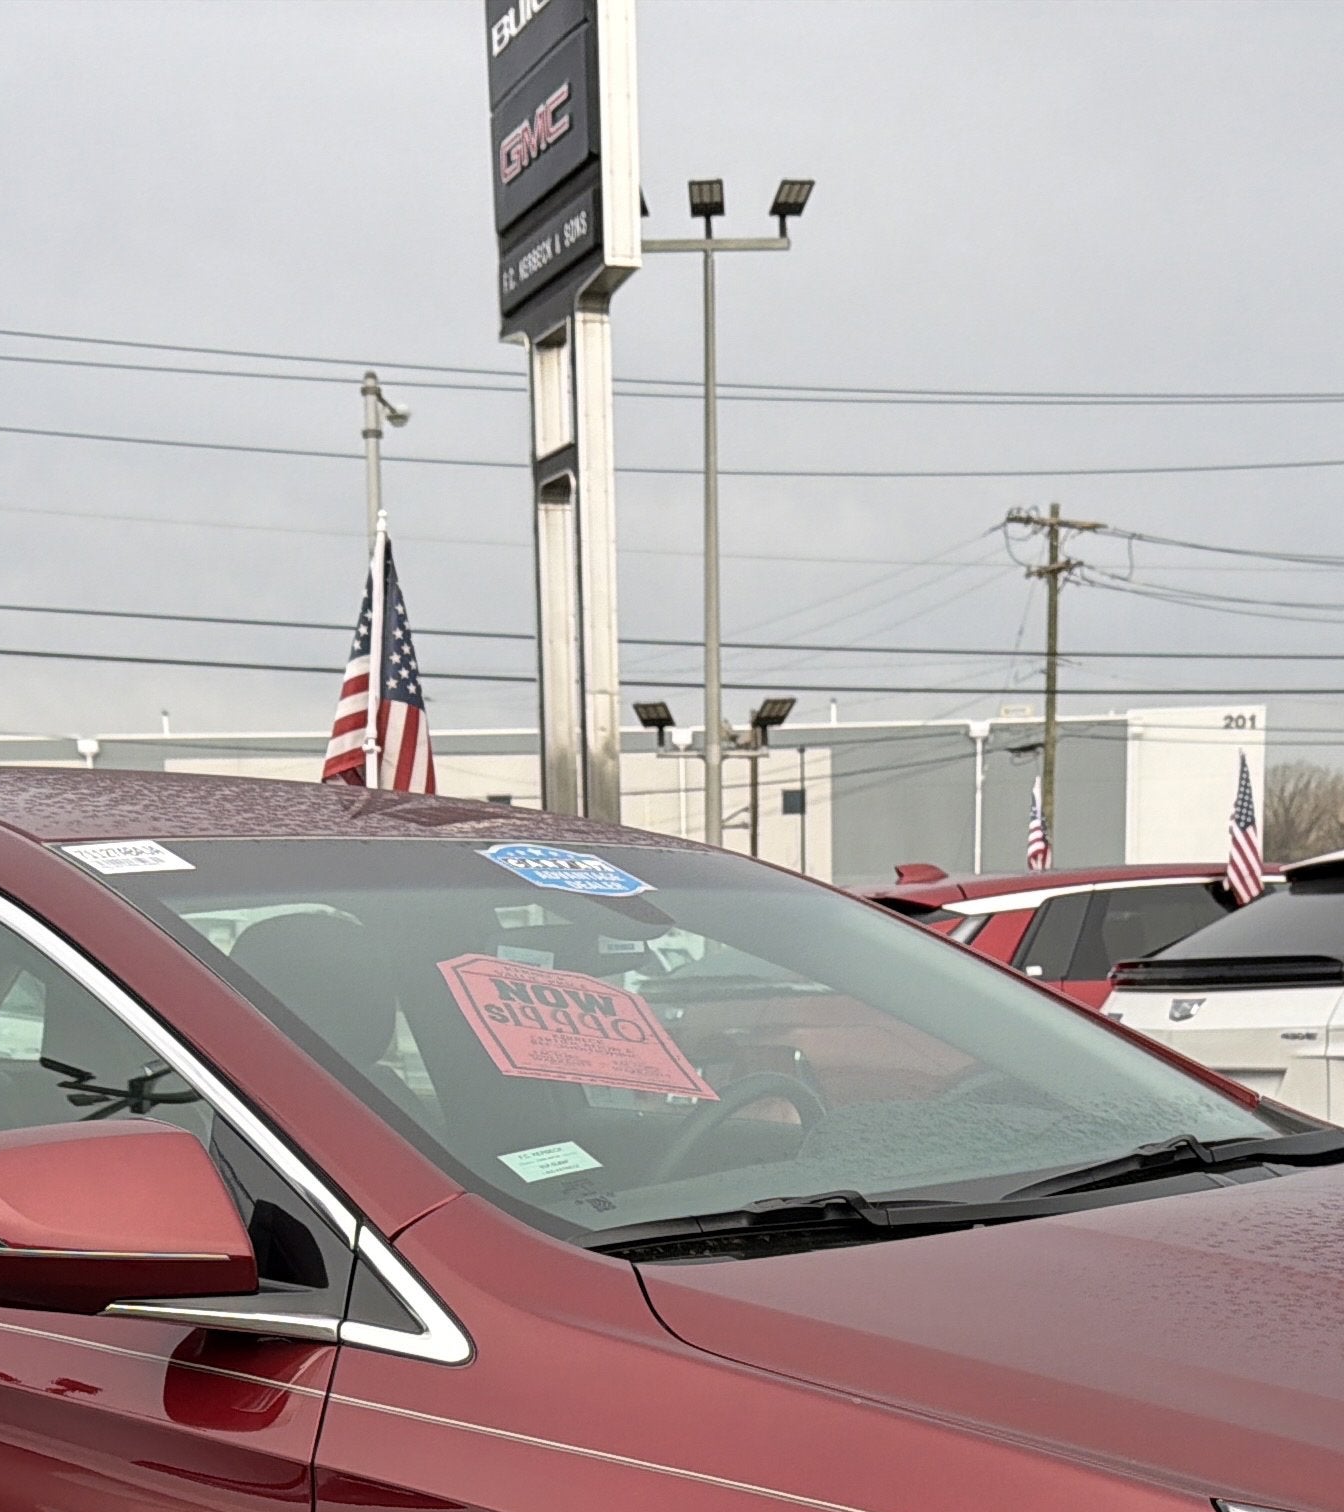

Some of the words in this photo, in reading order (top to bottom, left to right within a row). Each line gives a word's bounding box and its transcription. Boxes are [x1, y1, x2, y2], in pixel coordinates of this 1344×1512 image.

[492, 0, 550, 56] BUI
[499, 80, 570, 184] GMC
[563, 210, 588, 248] SONS
[1223, 714, 1257, 730] 201
[489, 976, 618, 1017] NOW
